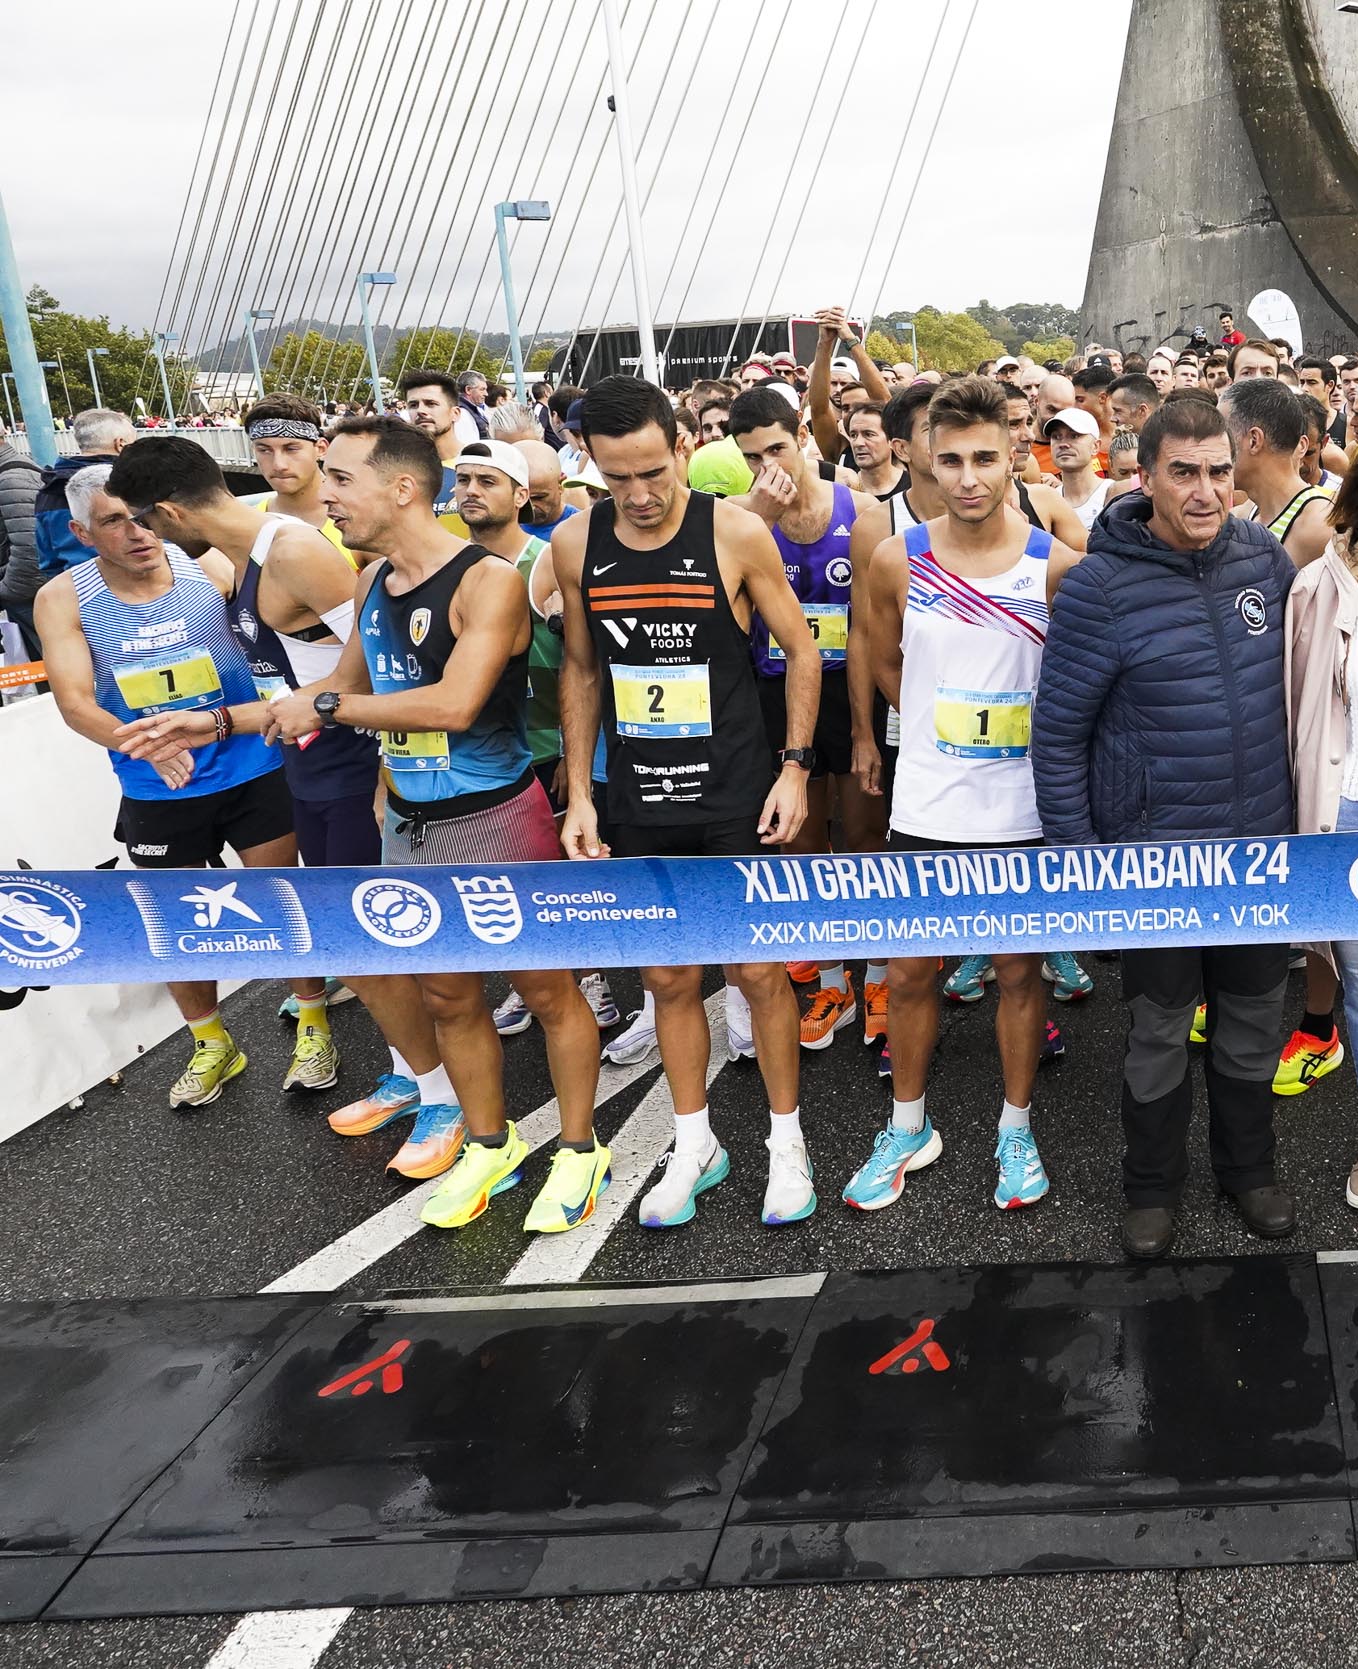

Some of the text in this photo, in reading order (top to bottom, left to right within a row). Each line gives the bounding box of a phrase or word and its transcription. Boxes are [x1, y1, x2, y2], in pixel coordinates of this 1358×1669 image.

[642, 623, 697, 637] VICKY
[650, 638, 693, 649] FOODS
[159, 669, 176, 693] 7
[647, 684, 665, 713] 2
[976, 709, 989, 736] 1
[733, 841, 1290, 903] XLII GRAN FONDO CAIXABANK 24
[366, 885, 420, 901] DEPORTE
[531, 890, 617, 905] Concello
[366, 908, 432, 938] PONTEVEDRA
[536, 905, 677, 923] de Pontevedra
[749, 921, 806, 945] XXIX
[808, 918, 884, 943] MEDIO
[887, 910, 1007, 940] MARATÓN
[1010, 913, 1042, 936] DE
[1045, 907, 1202, 934] PONTEVEDRA
[178, 933, 283, 954] CaixaBank
[0, 946, 84, 970] PONTEVEDRA
